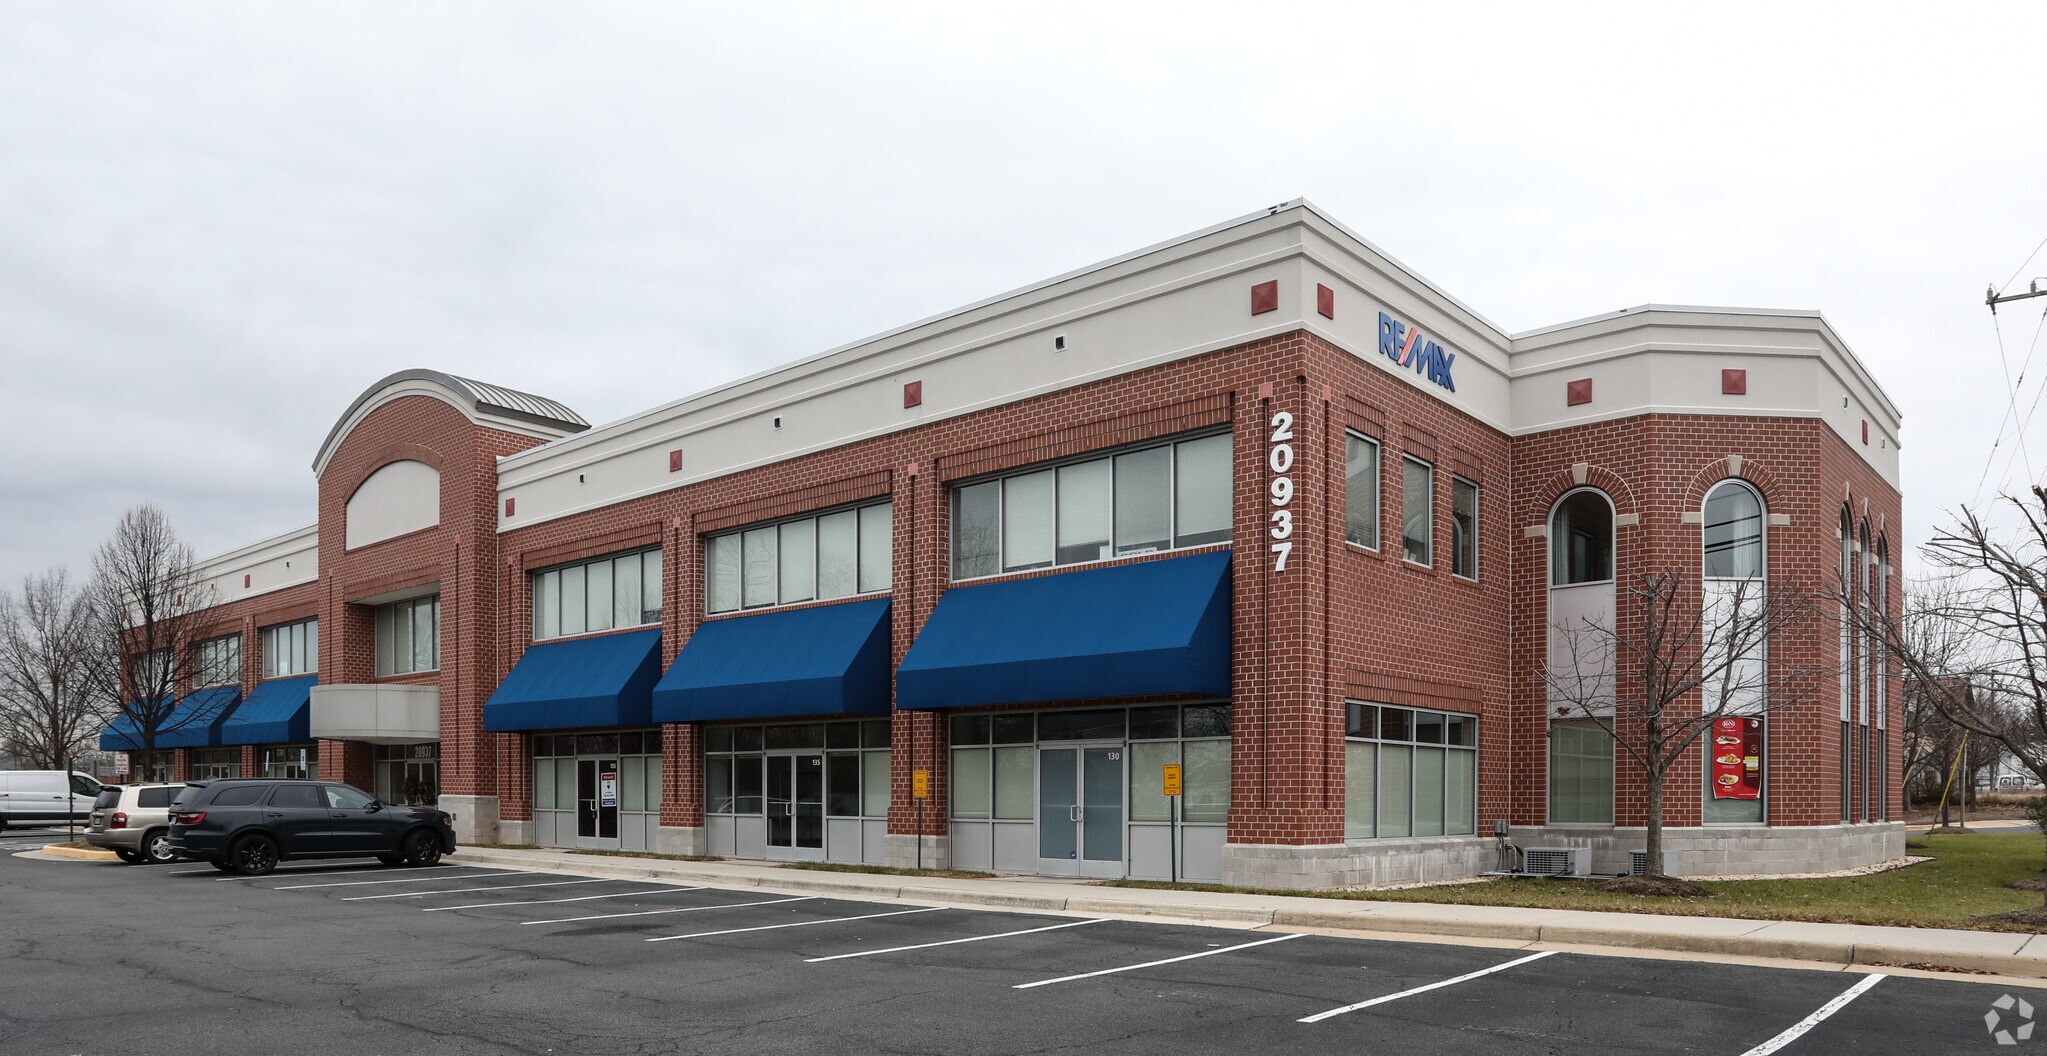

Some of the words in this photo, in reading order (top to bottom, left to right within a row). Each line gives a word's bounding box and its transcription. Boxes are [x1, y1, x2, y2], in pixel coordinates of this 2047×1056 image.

[1379, 311, 1456, 393] RE/MAX
[1270, 411, 1294, 572] 20937
[415, 746, 431, 758] 20937
[1107, 752, 1119, 760] 130
